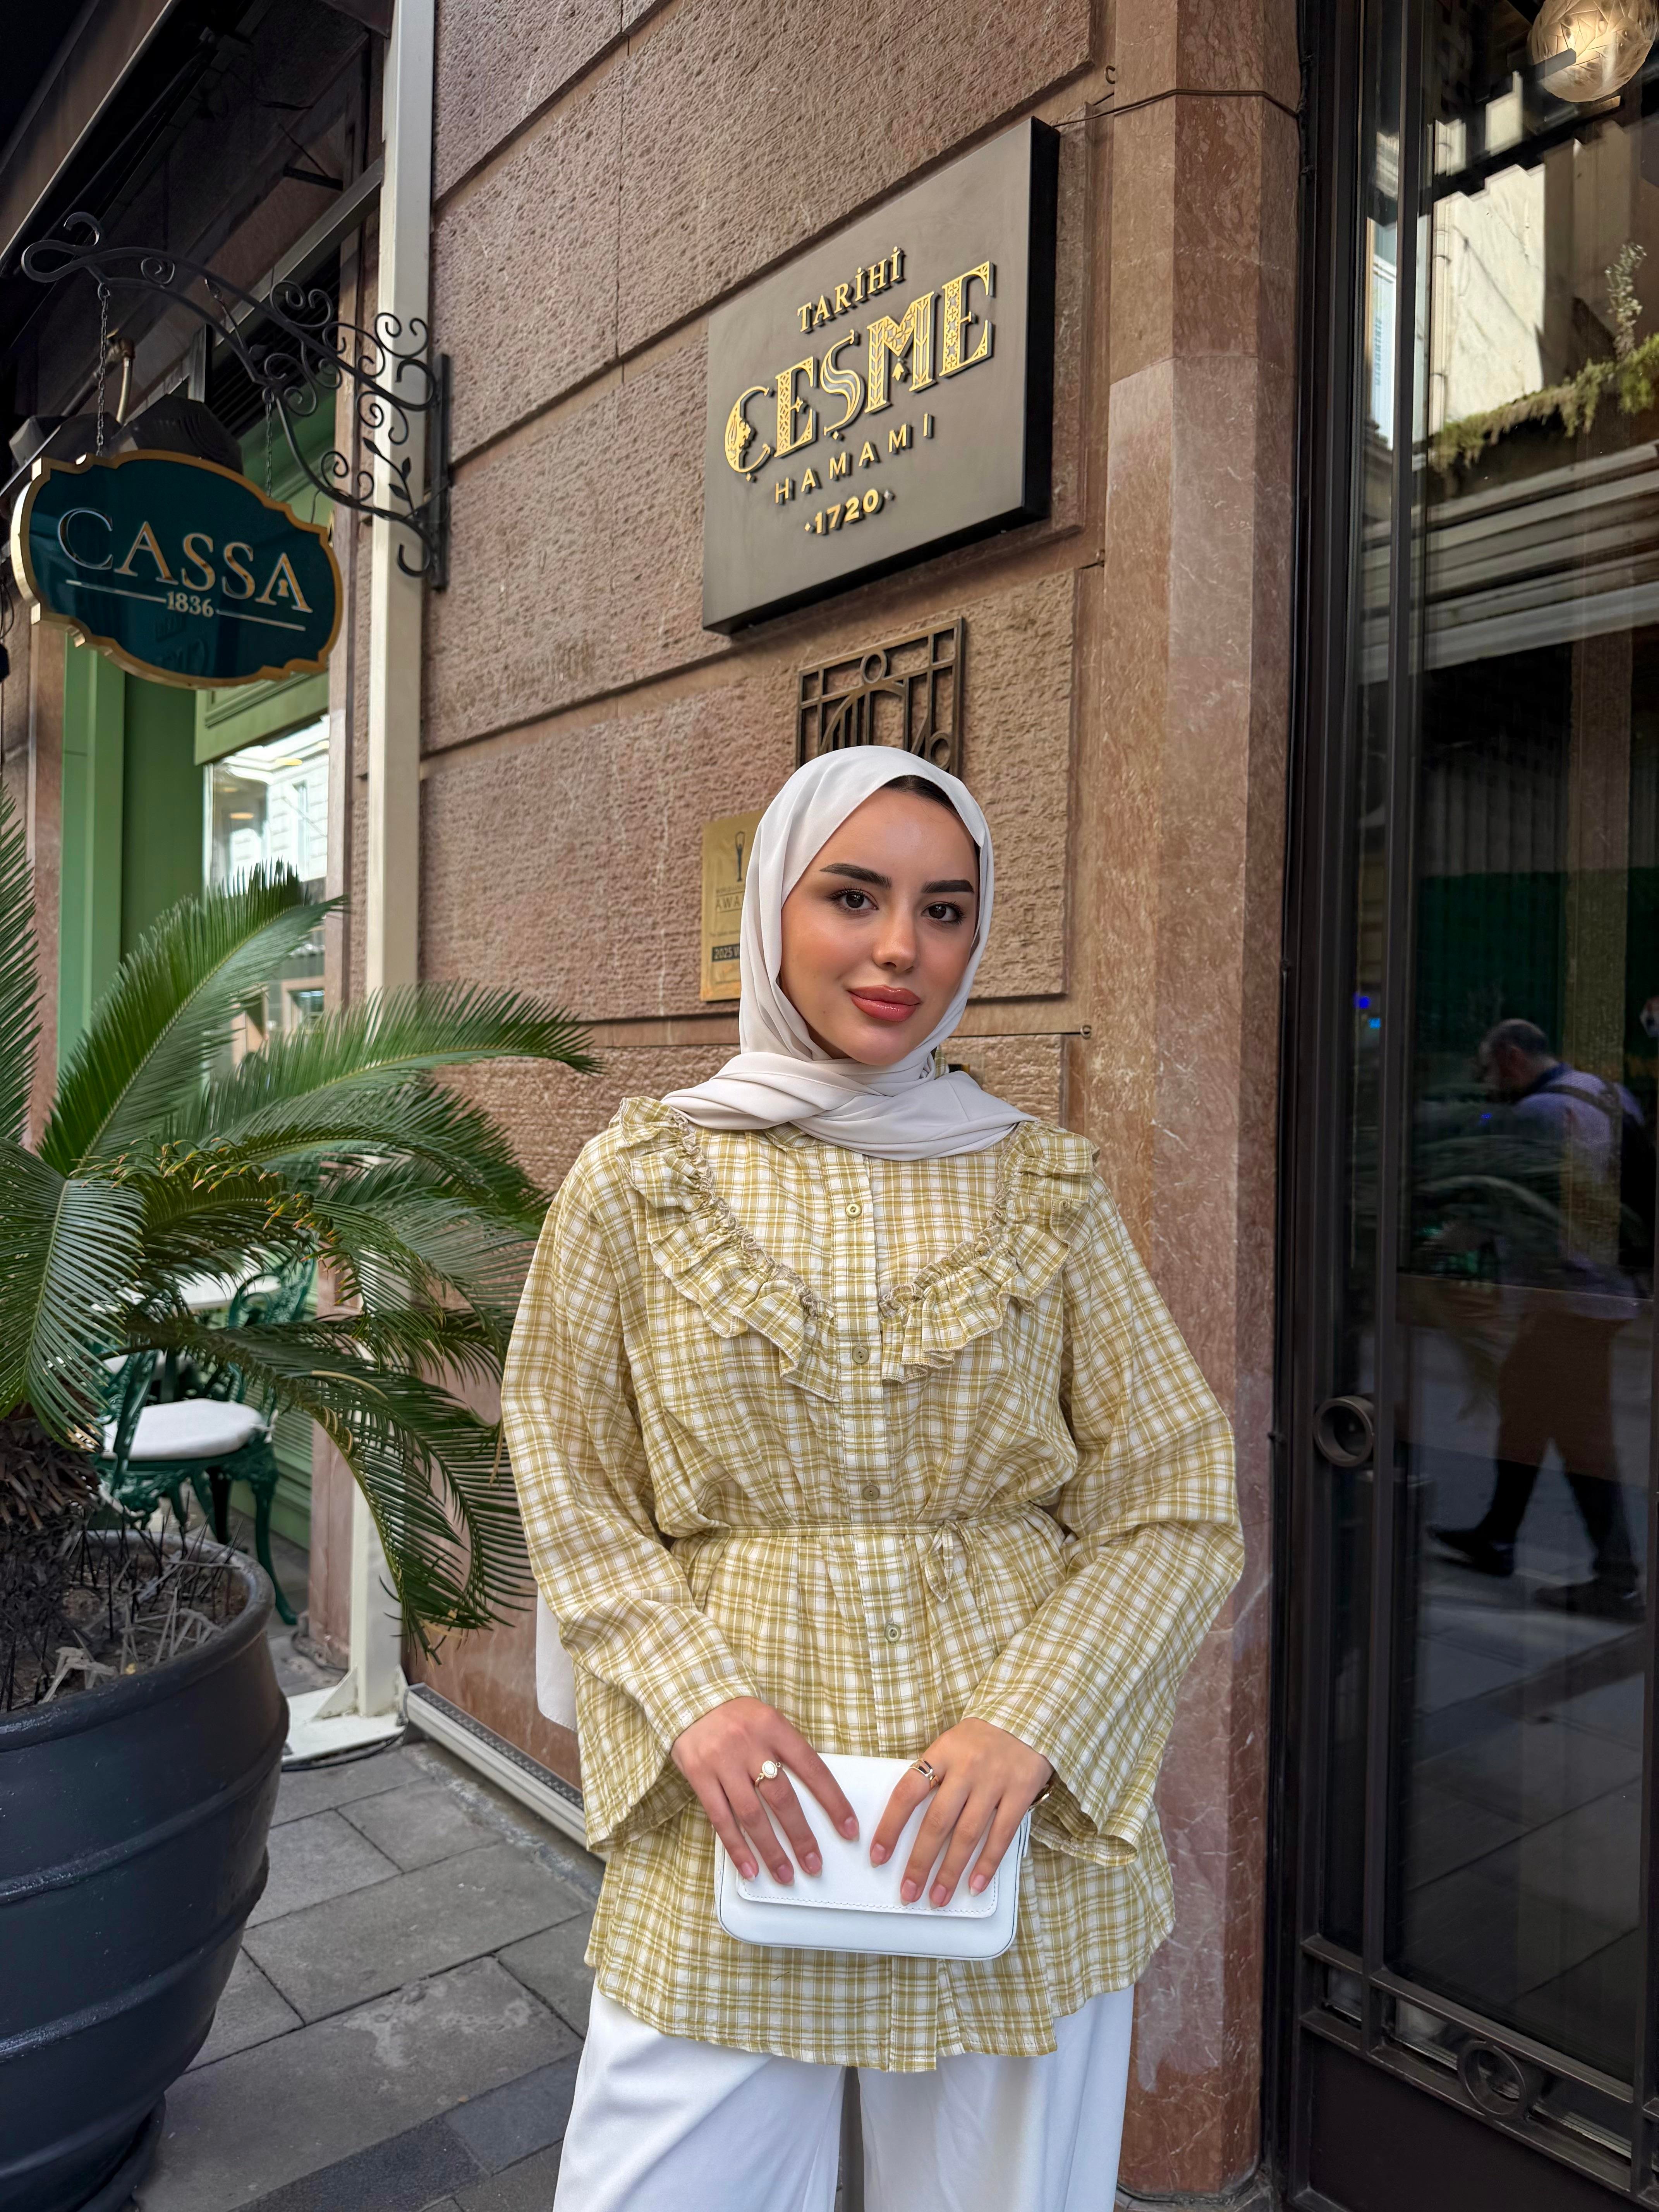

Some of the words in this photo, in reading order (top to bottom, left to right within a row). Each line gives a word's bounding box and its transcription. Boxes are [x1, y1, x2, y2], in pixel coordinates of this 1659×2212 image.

[797, 246, 901, 332] TARİHİ
[724, 261, 991, 481] ÇEŞME
[775, 413, 933, 503] HAMAMI
[57, 508, 313, 613] CASSA
[167, 592, 215, 617] 1836
[715, 895, 741, 910] AWA
